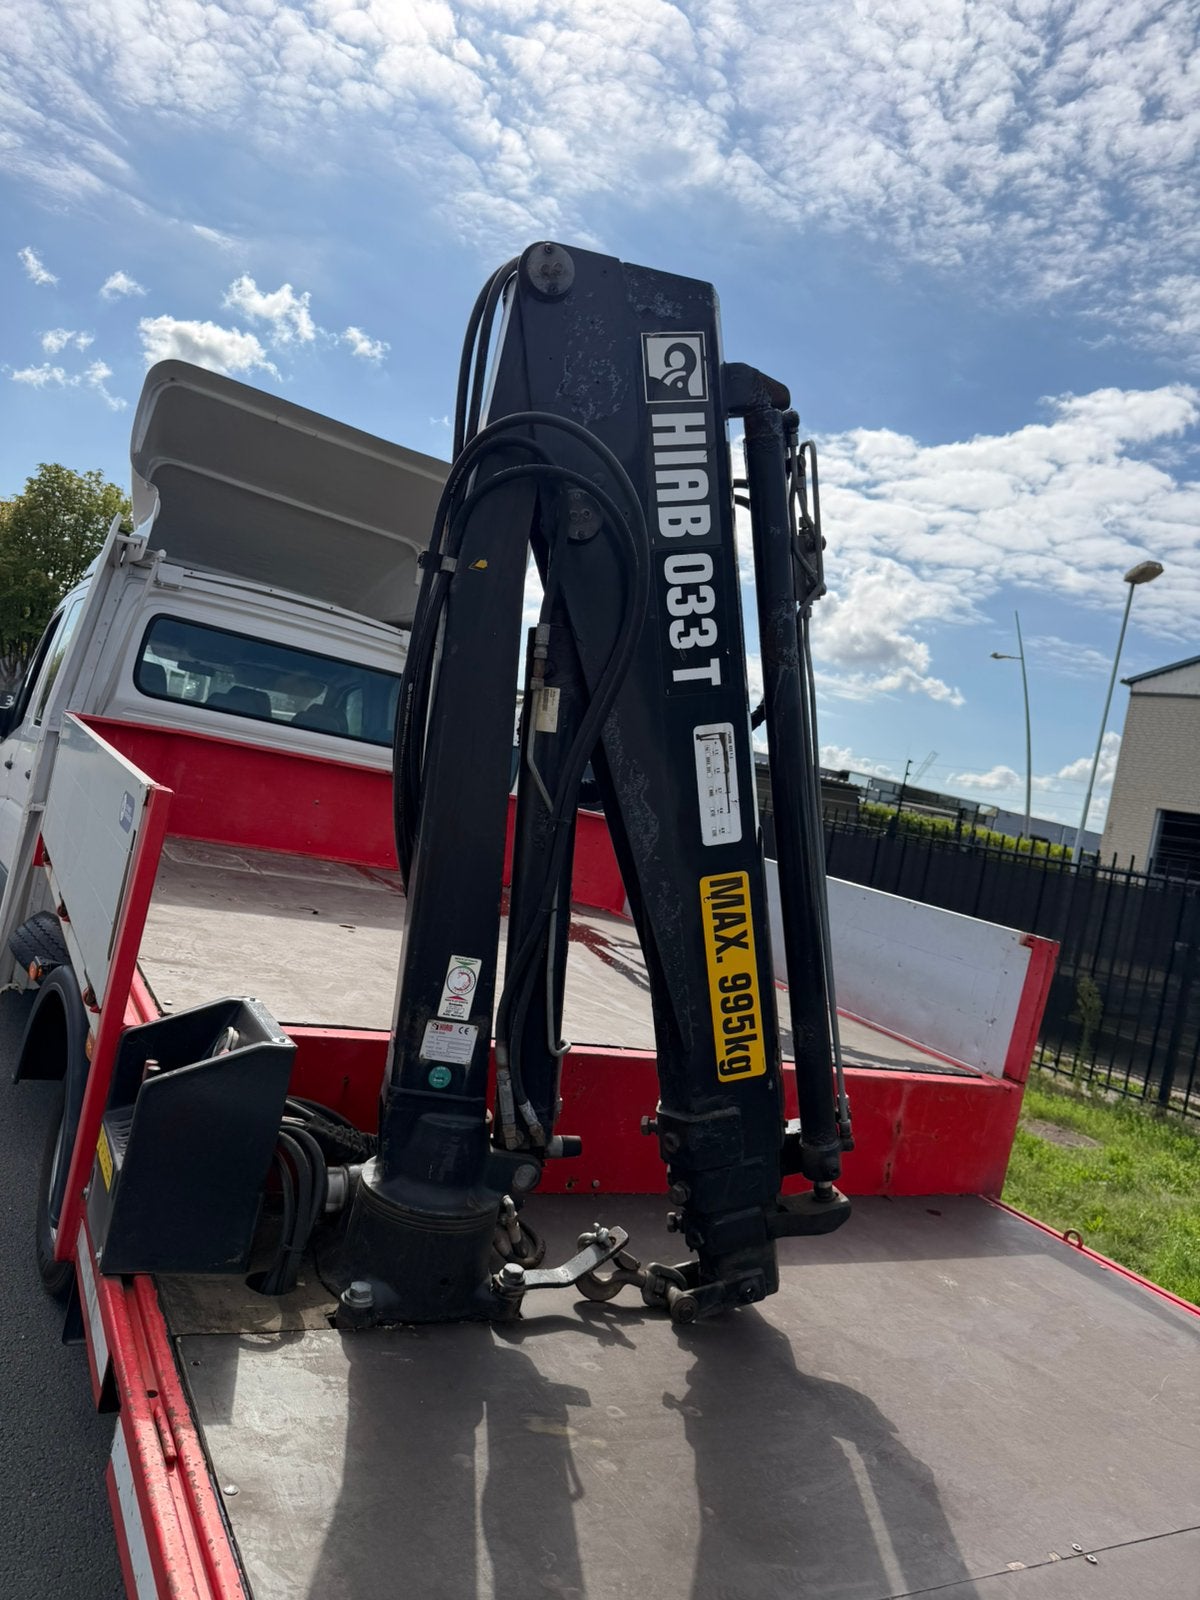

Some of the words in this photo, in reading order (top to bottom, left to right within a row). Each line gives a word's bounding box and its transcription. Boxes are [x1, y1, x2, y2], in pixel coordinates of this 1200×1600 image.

[652, 412, 711, 538] HIAB
[664, 553, 718, 650] 033
[672, 658, 721, 686] T
[708, 875, 750, 964] MAX.
[718, 972, 758, 1077] 995kg
